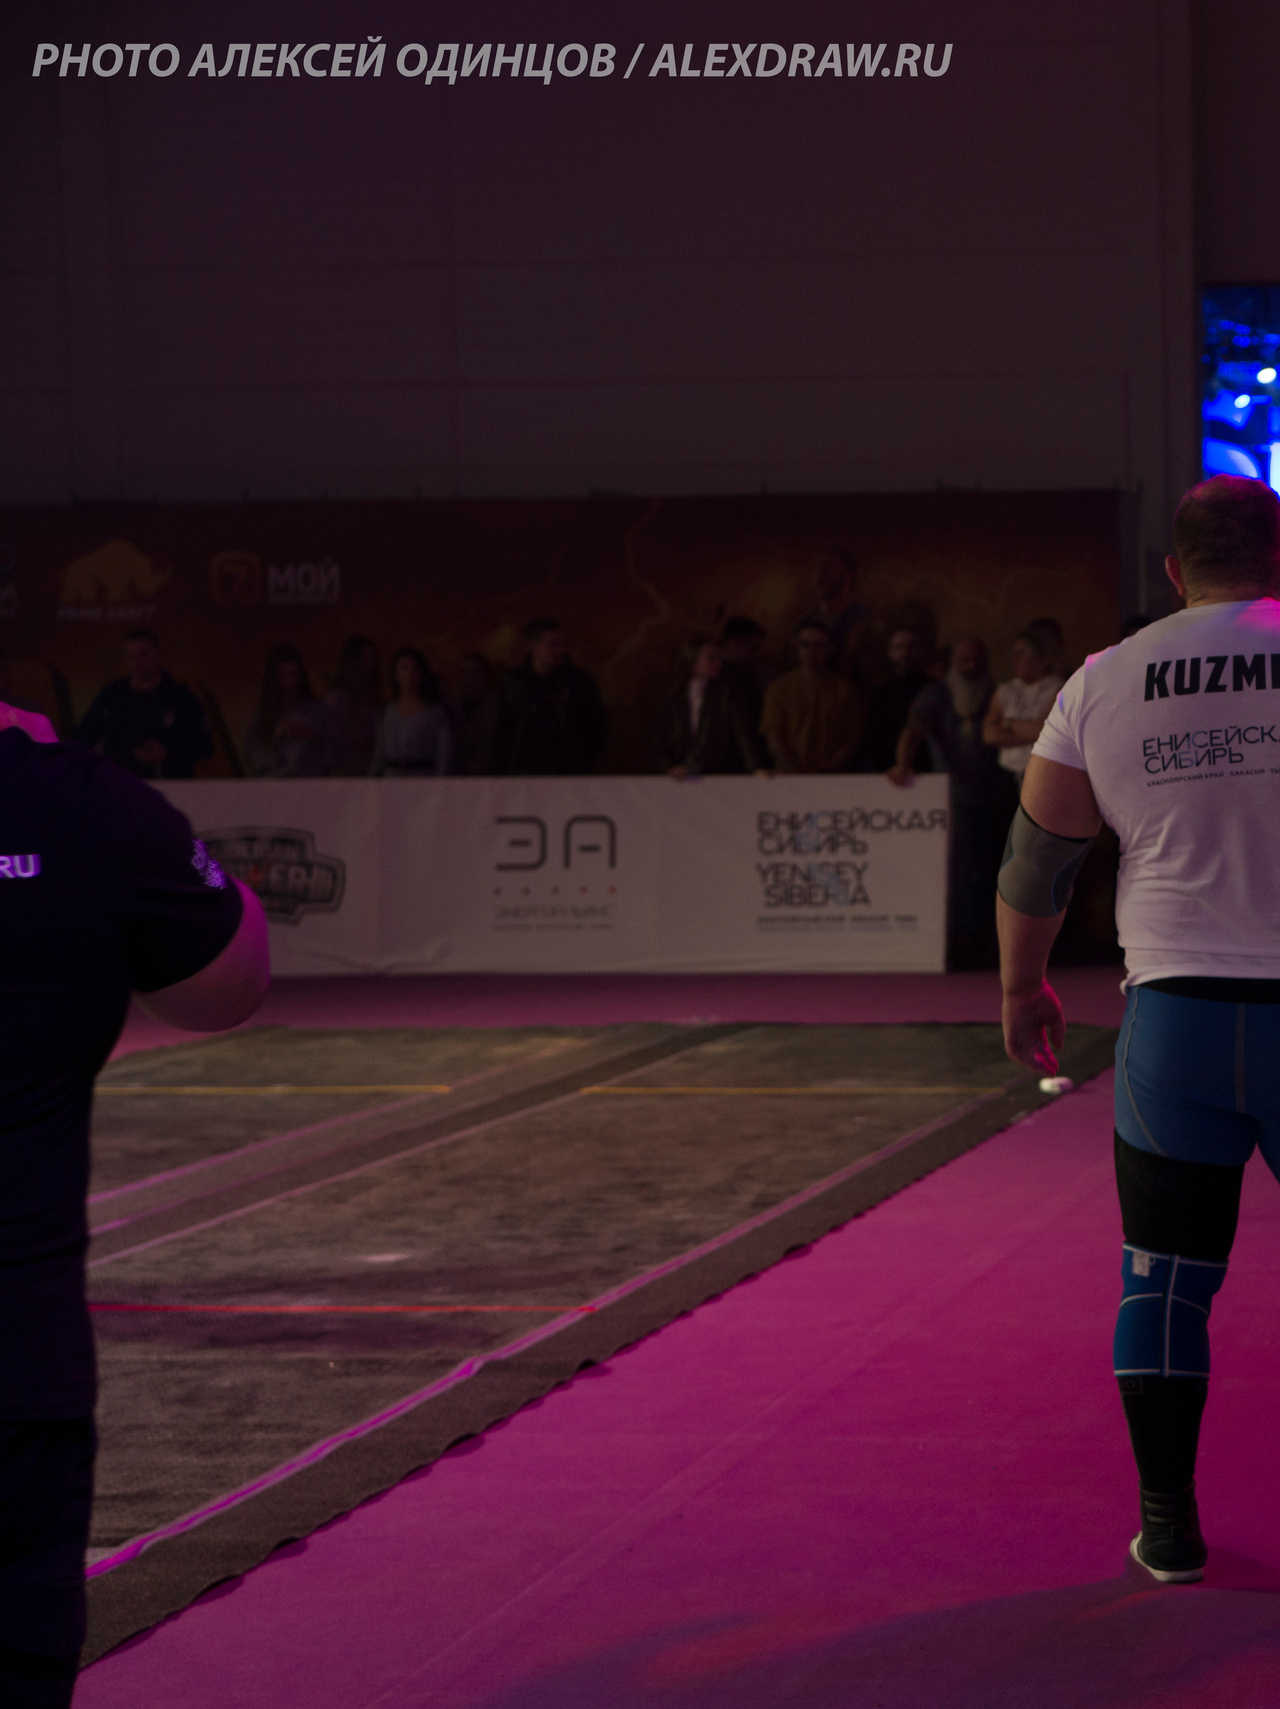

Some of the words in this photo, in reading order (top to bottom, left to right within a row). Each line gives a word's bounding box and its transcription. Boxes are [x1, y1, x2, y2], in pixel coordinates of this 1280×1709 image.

[1145, 747, 1244, 774] СИБИРЬ
[1147, 772, 1203, 787] КРАСНОЯРСКИЙ
[1204, 770, 1225, 780] КРАЙ
[1229, 768, 1265, 777] ХАКАСИЯ
[758, 806, 946, 832] ЕНИСЕЙСКАЯ
[759, 830, 869, 855] СИБИРЬ
